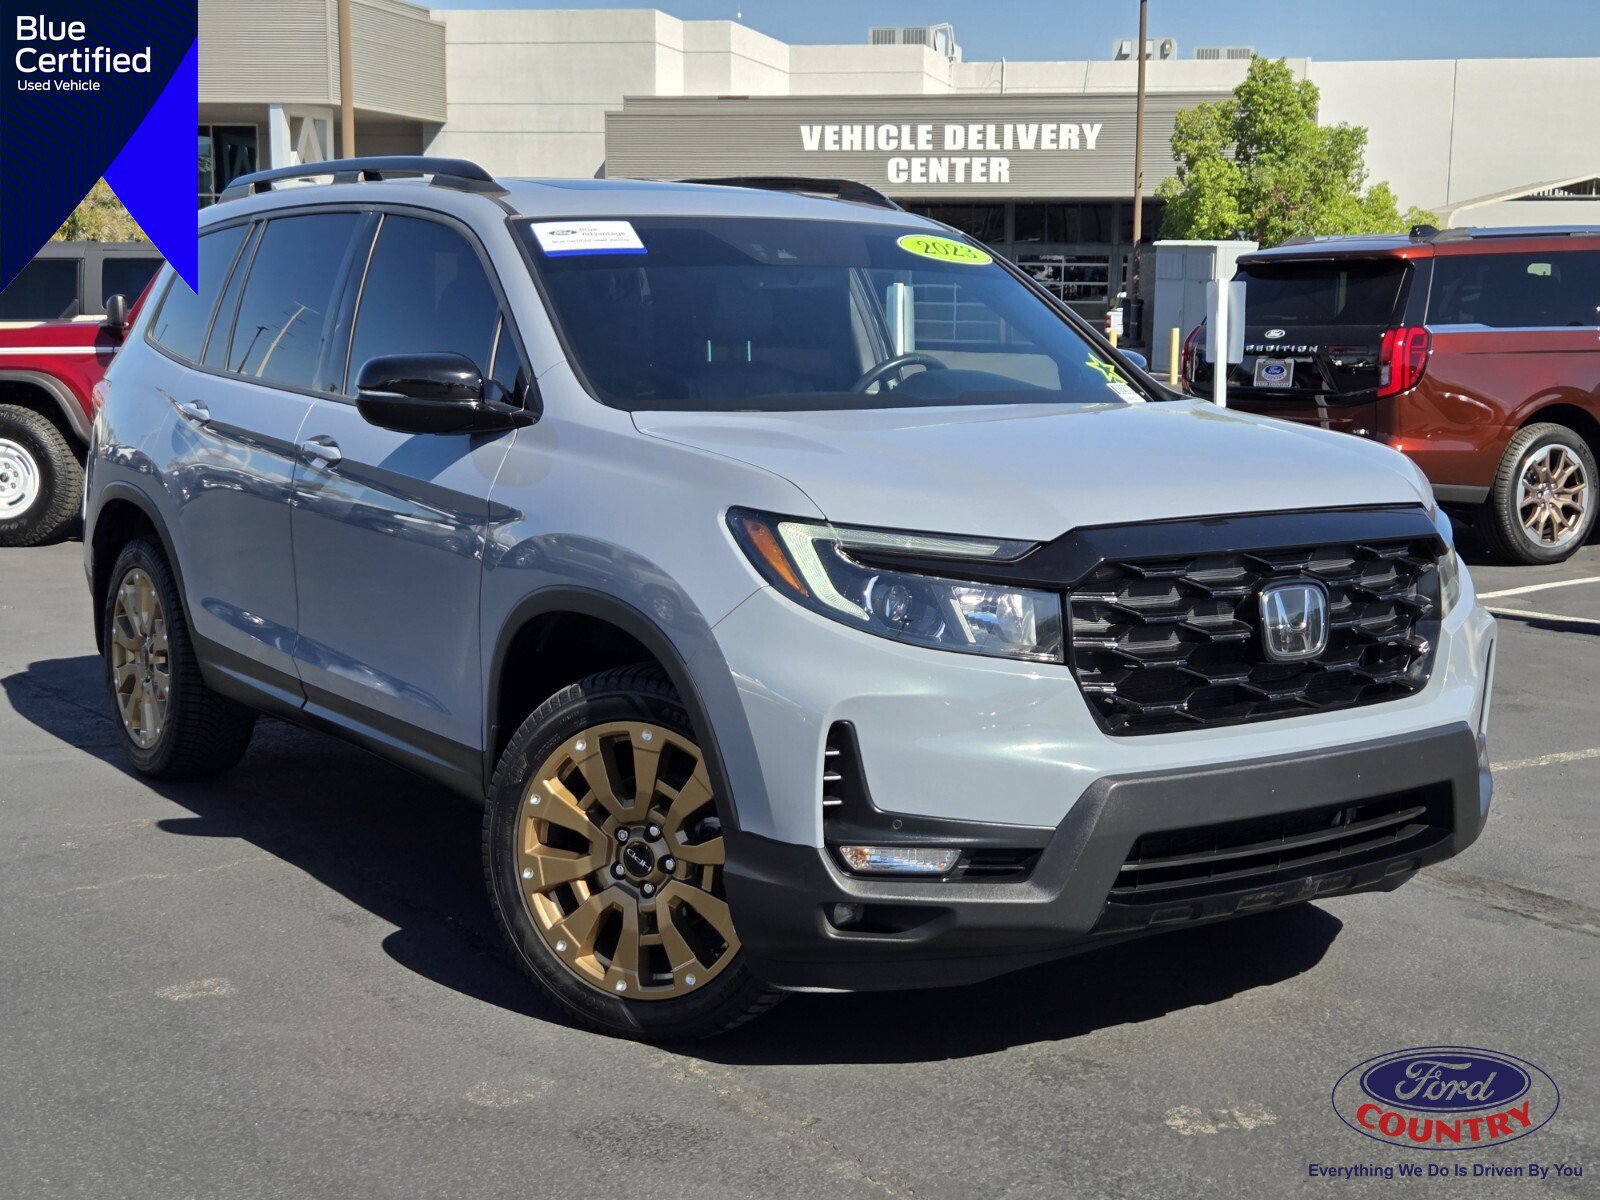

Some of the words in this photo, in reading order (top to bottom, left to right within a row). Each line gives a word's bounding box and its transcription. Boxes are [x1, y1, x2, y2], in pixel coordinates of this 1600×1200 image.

[800, 124, 933, 151] VEHICLE
[944, 123, 1103, 151] DELIVERY
[887, 156, 1011, 184] CENTER
[916, 240, 978, 259] 2023
[626, 848, 652, 872] HPD
